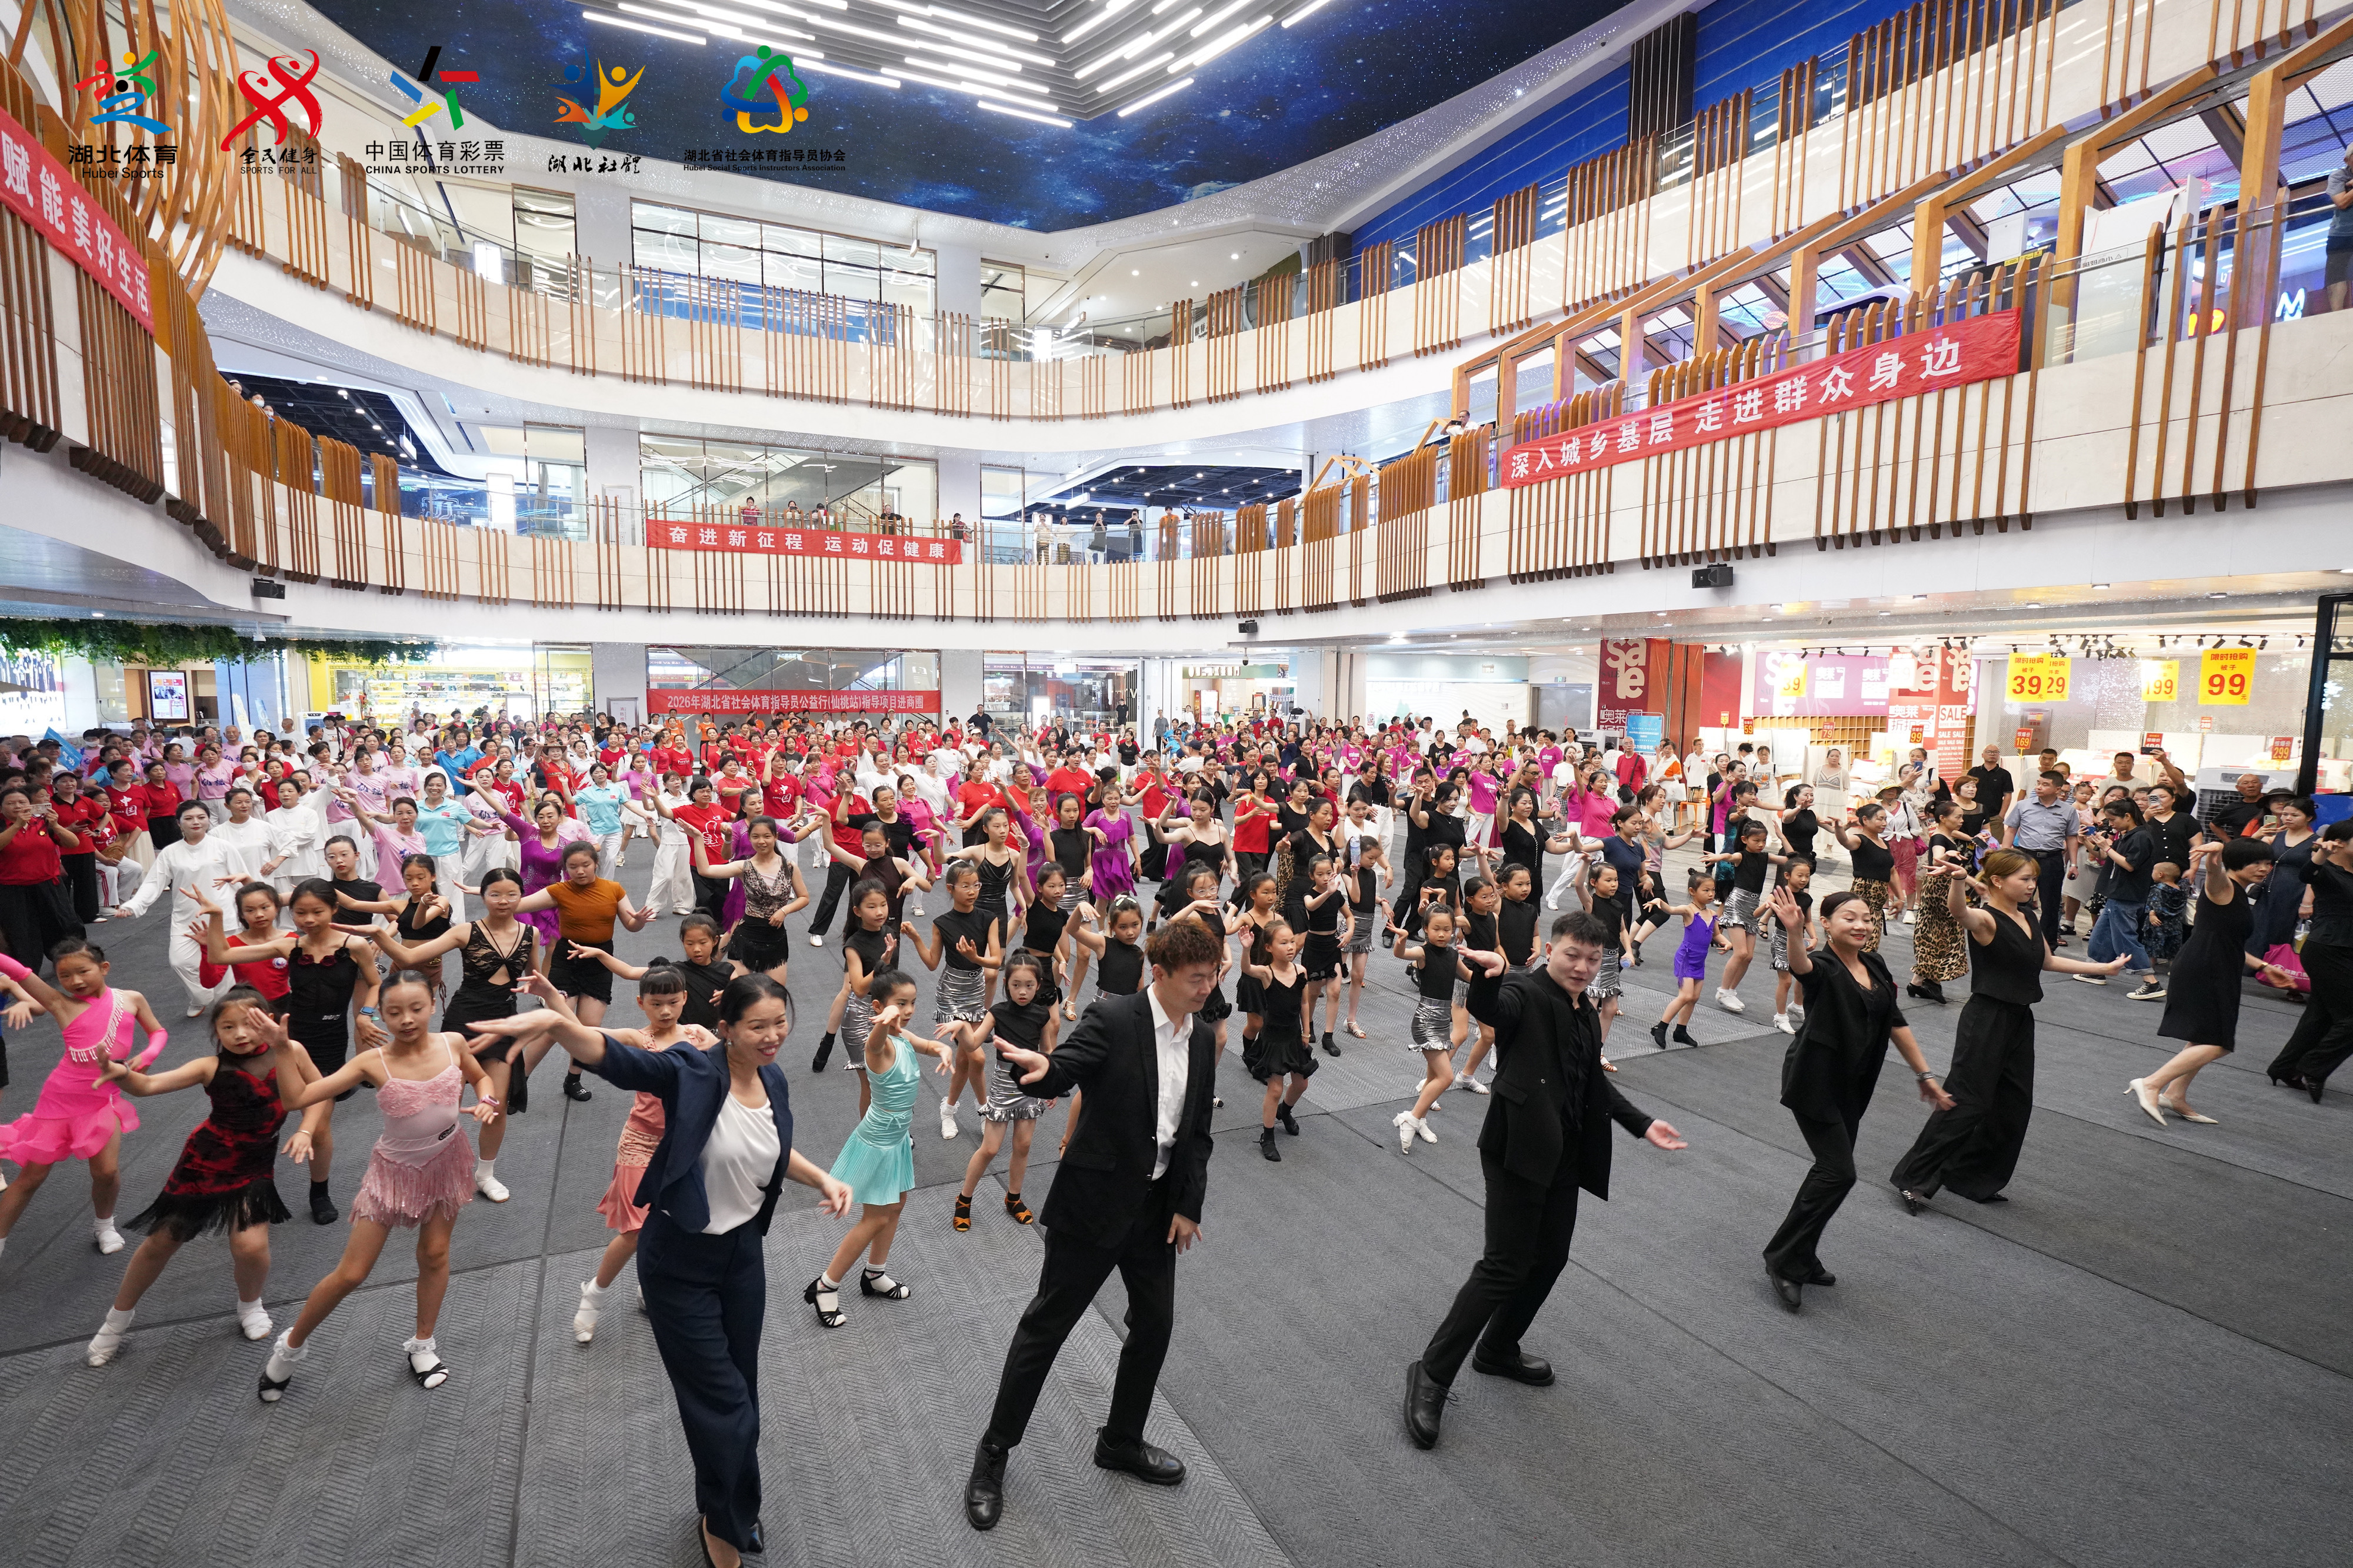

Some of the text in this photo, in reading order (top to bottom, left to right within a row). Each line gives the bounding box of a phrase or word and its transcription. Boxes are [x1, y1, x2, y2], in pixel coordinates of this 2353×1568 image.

[1, 130, 149, 317] 赋能美好生活
[1511, 336, 1962, 480] 深入城乡基层 走进群众身边
[669, 526, 945, 559] 奋进新征程 运动促健康
[1783, 677, 1801, 690] 39
[2012, 675, 2042, 695] 39
[2146, 679, 2174, 695] 199
[2208, 673, 2246, 696] 99
[667, 694, 924, 710] 2026年湖北省社会体育指导员公益行(仙桃站)指导项目进商圈
[1940, 708, 1967, 721] SALE
[1744, 725, 1753, 734] 59
[1823, 730, 1833, 739] 79
[1910, 732, 1922, 742] 99
[2015, 737, 2029, 747] 169
[2272, 746, 2289, 759] 299
[356, 783, 382, 796] 仙桃
